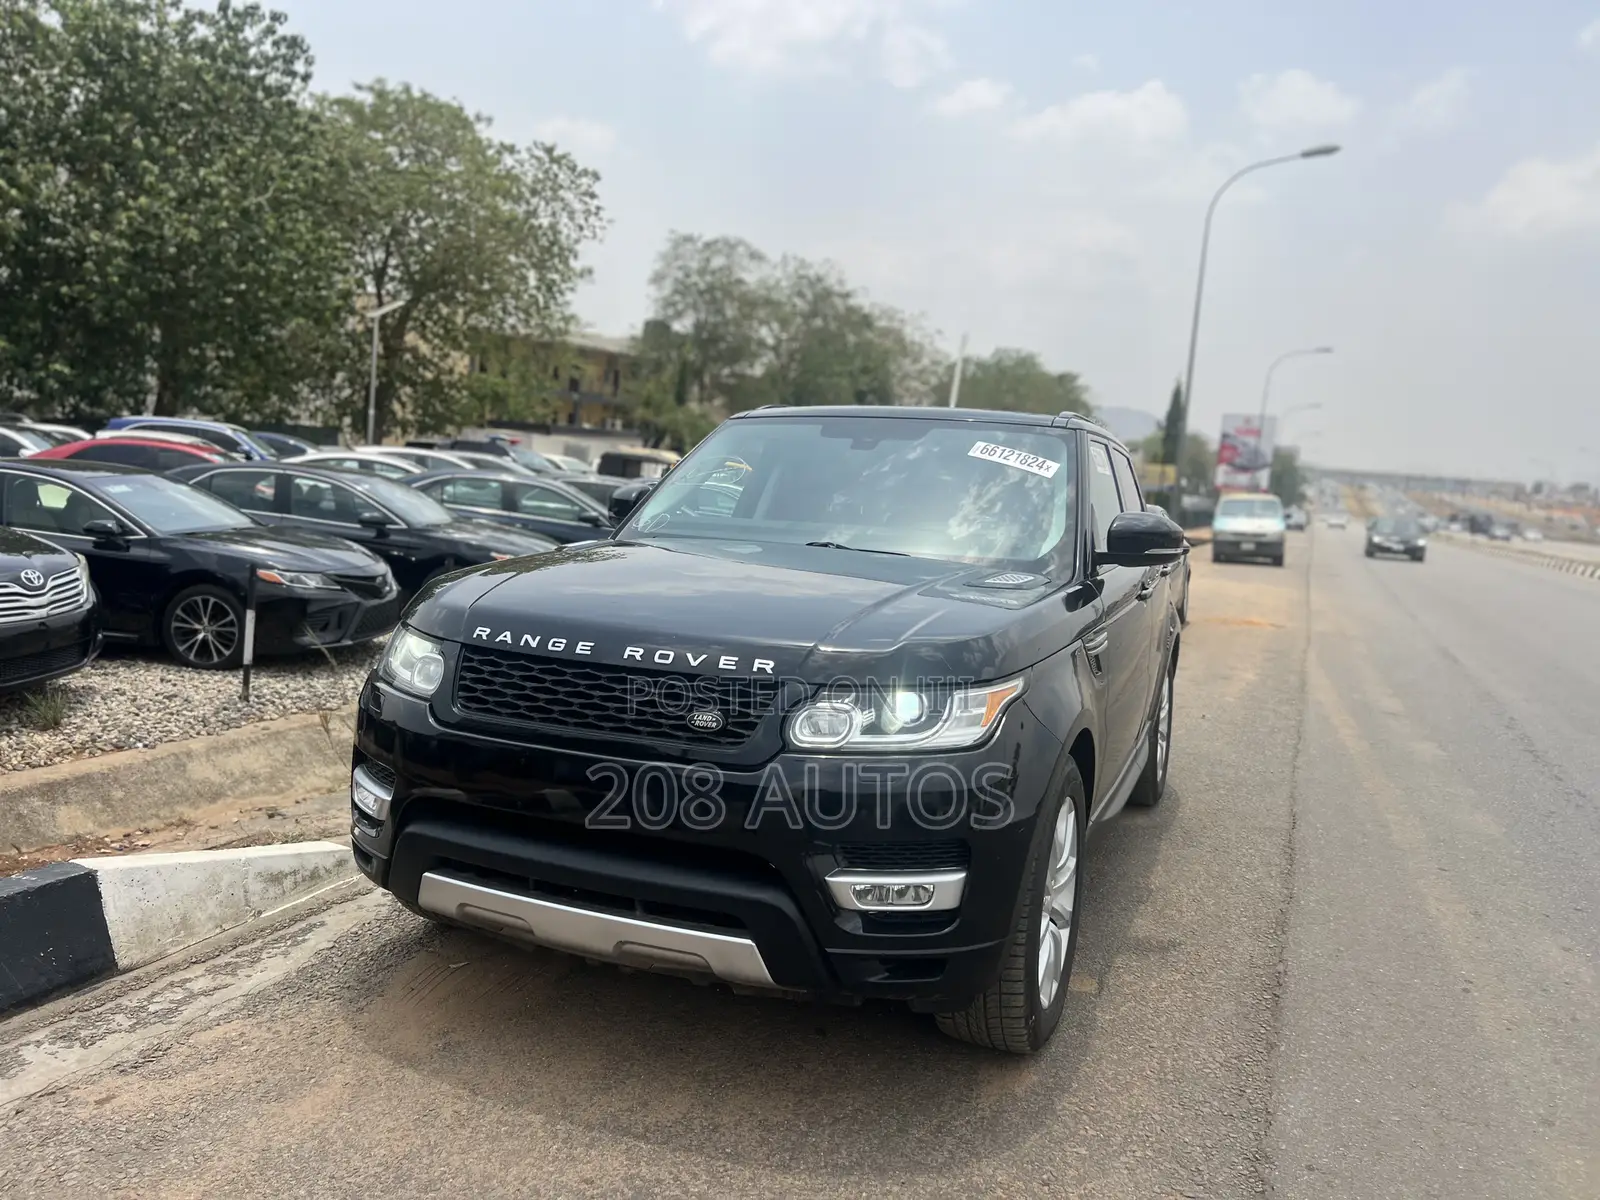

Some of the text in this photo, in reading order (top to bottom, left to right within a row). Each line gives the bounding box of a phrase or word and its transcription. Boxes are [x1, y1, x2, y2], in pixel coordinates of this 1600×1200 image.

[472, 626, 776, 674] RANGE ROVER
[695, 720, 717, 728] ROVER
